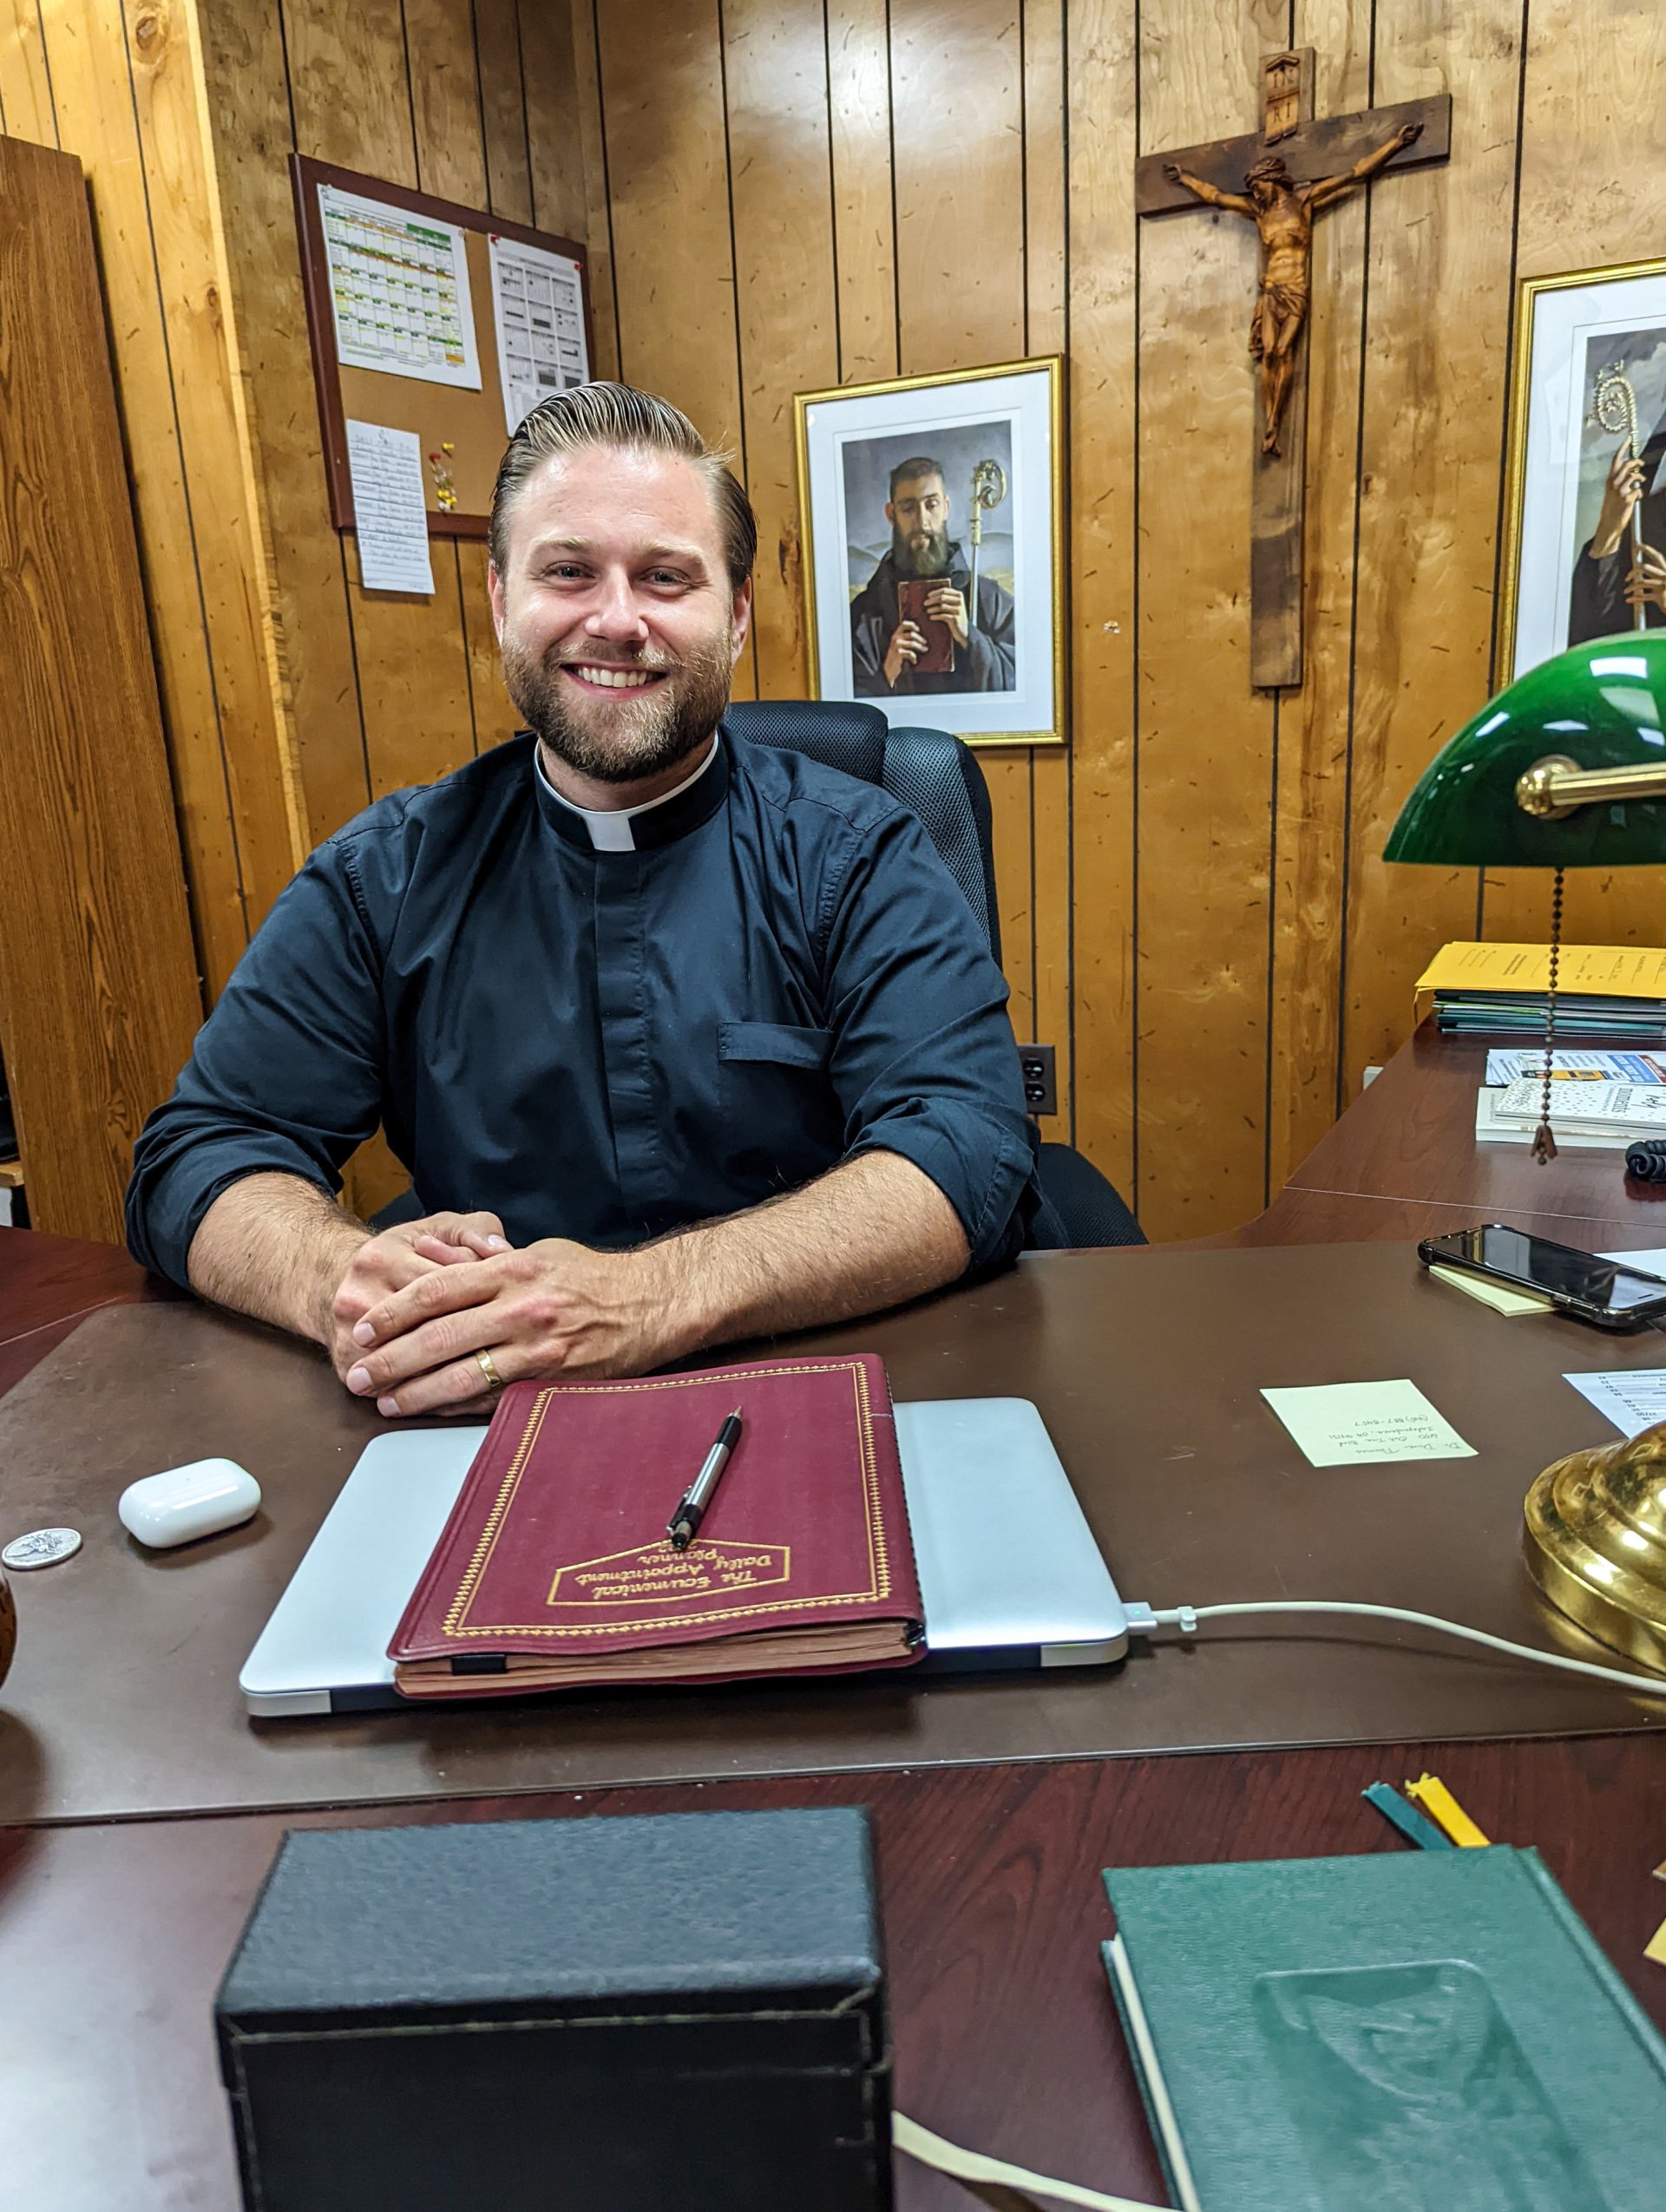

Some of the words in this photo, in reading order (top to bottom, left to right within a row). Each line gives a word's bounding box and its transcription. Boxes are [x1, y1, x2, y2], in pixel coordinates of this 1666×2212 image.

[637, 1548, 719, 1565] Planner
[713, 1554, 771, 1570] Daily
[574, 1562, 705, 1586] Appointment
[721, 1569, 758, 1584] The
[591, 1576, 712, 1600] Ecumenical
